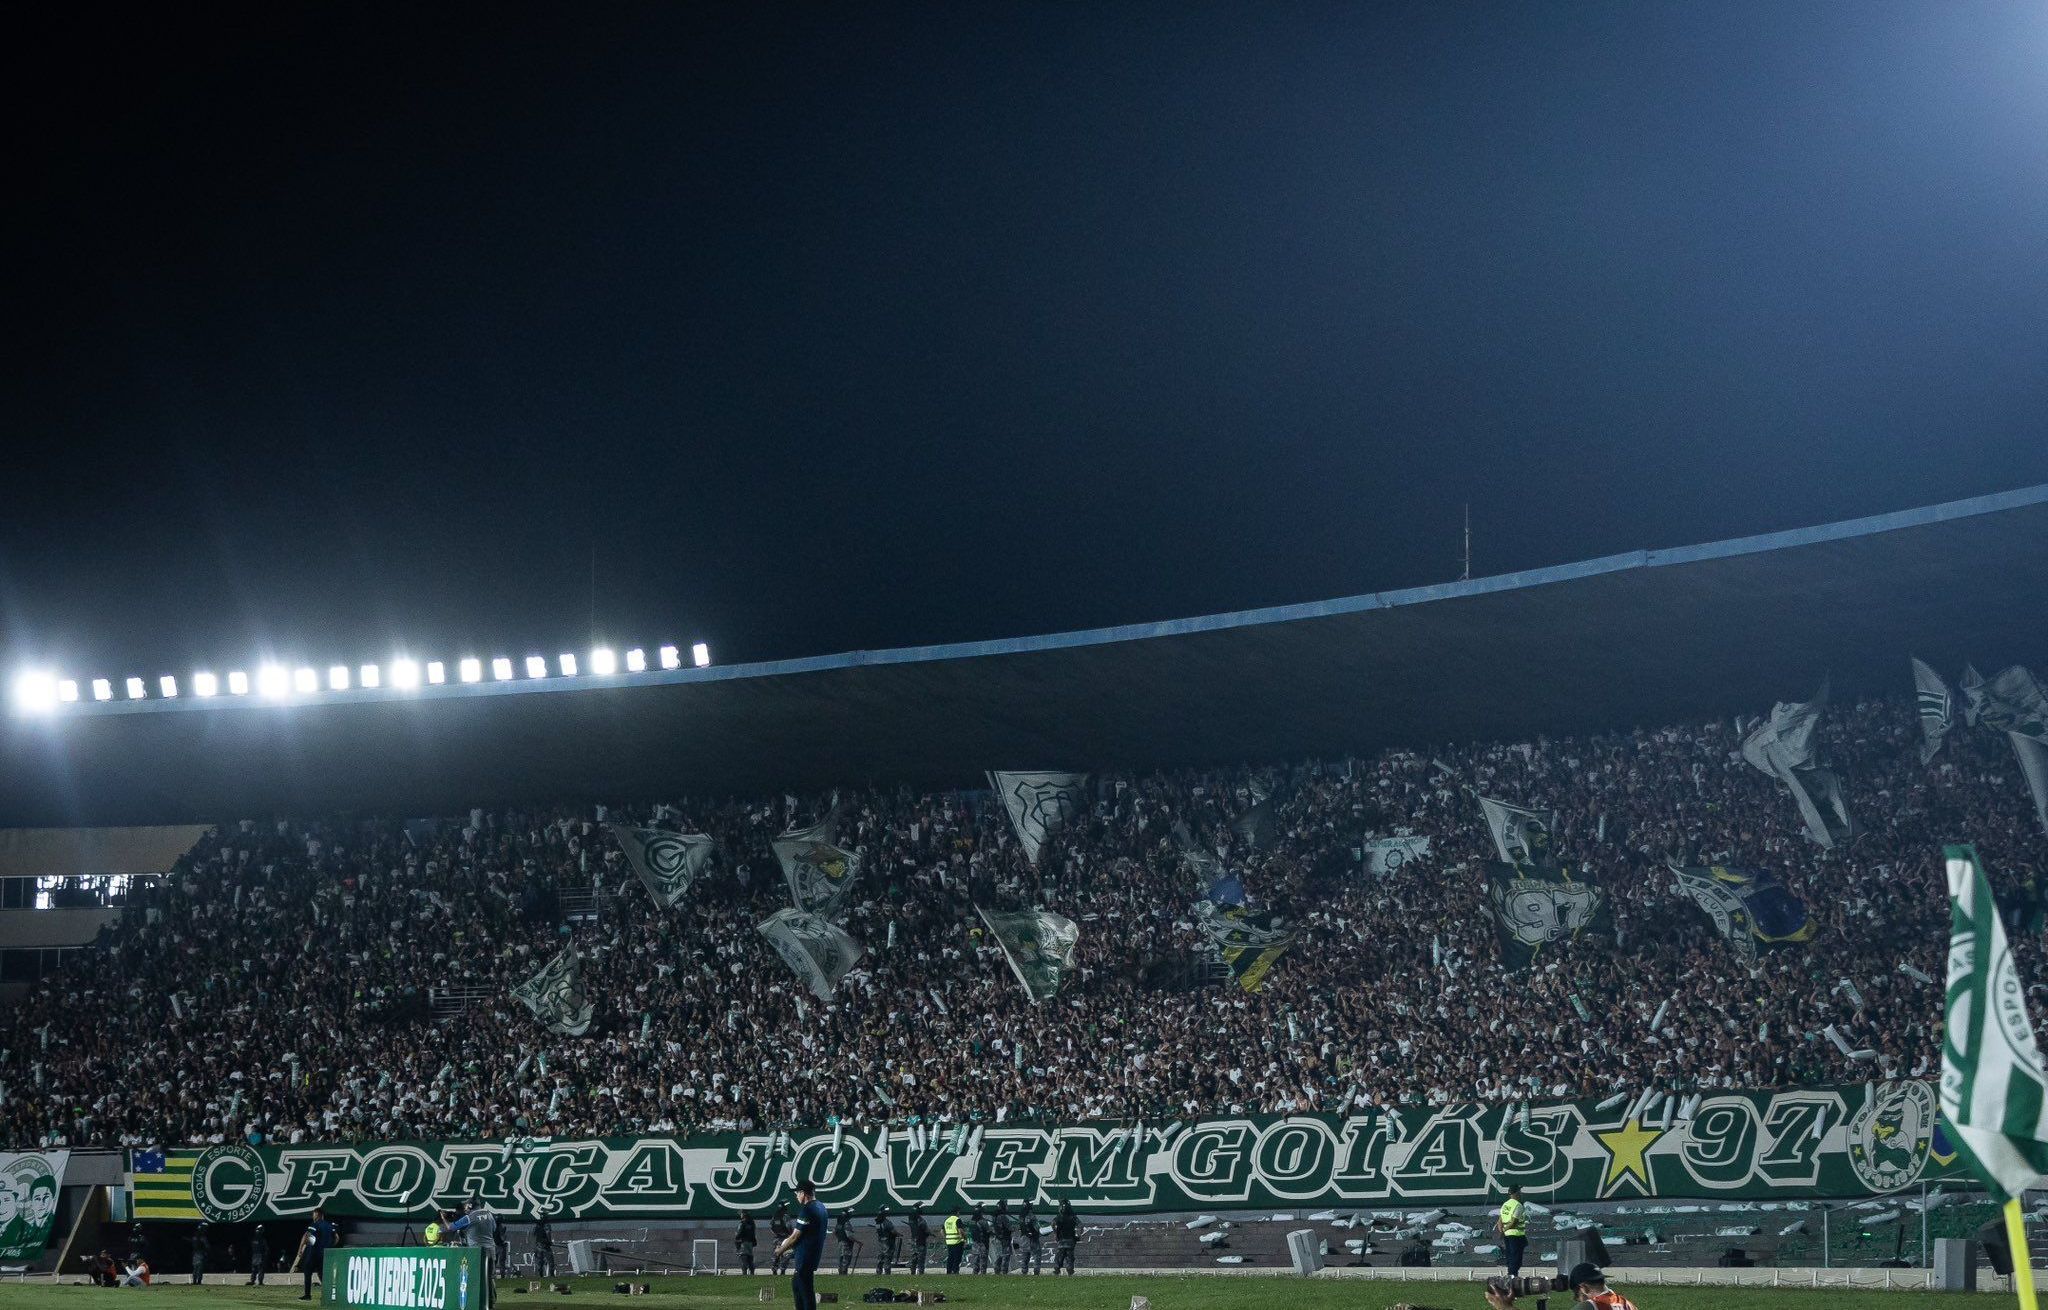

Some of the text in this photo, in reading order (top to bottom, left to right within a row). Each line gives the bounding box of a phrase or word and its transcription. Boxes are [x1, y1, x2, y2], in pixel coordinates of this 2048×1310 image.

[1695, 892, 1726, 926] CLUBE
[207, 1145, 252, 1161] ESPORTE
[270, 1138, 694, 1217] FORÇA
[706, 1127, 1154, 1210] JOVEM
[1169, 1102, 1582, 1200] GOIÁS
[1681, 1090, 1847, 1188] 97
[251, 1165, 262, 1200] CLUBE
[347, 1256, 447, 1309] COPA VERDE 2025
